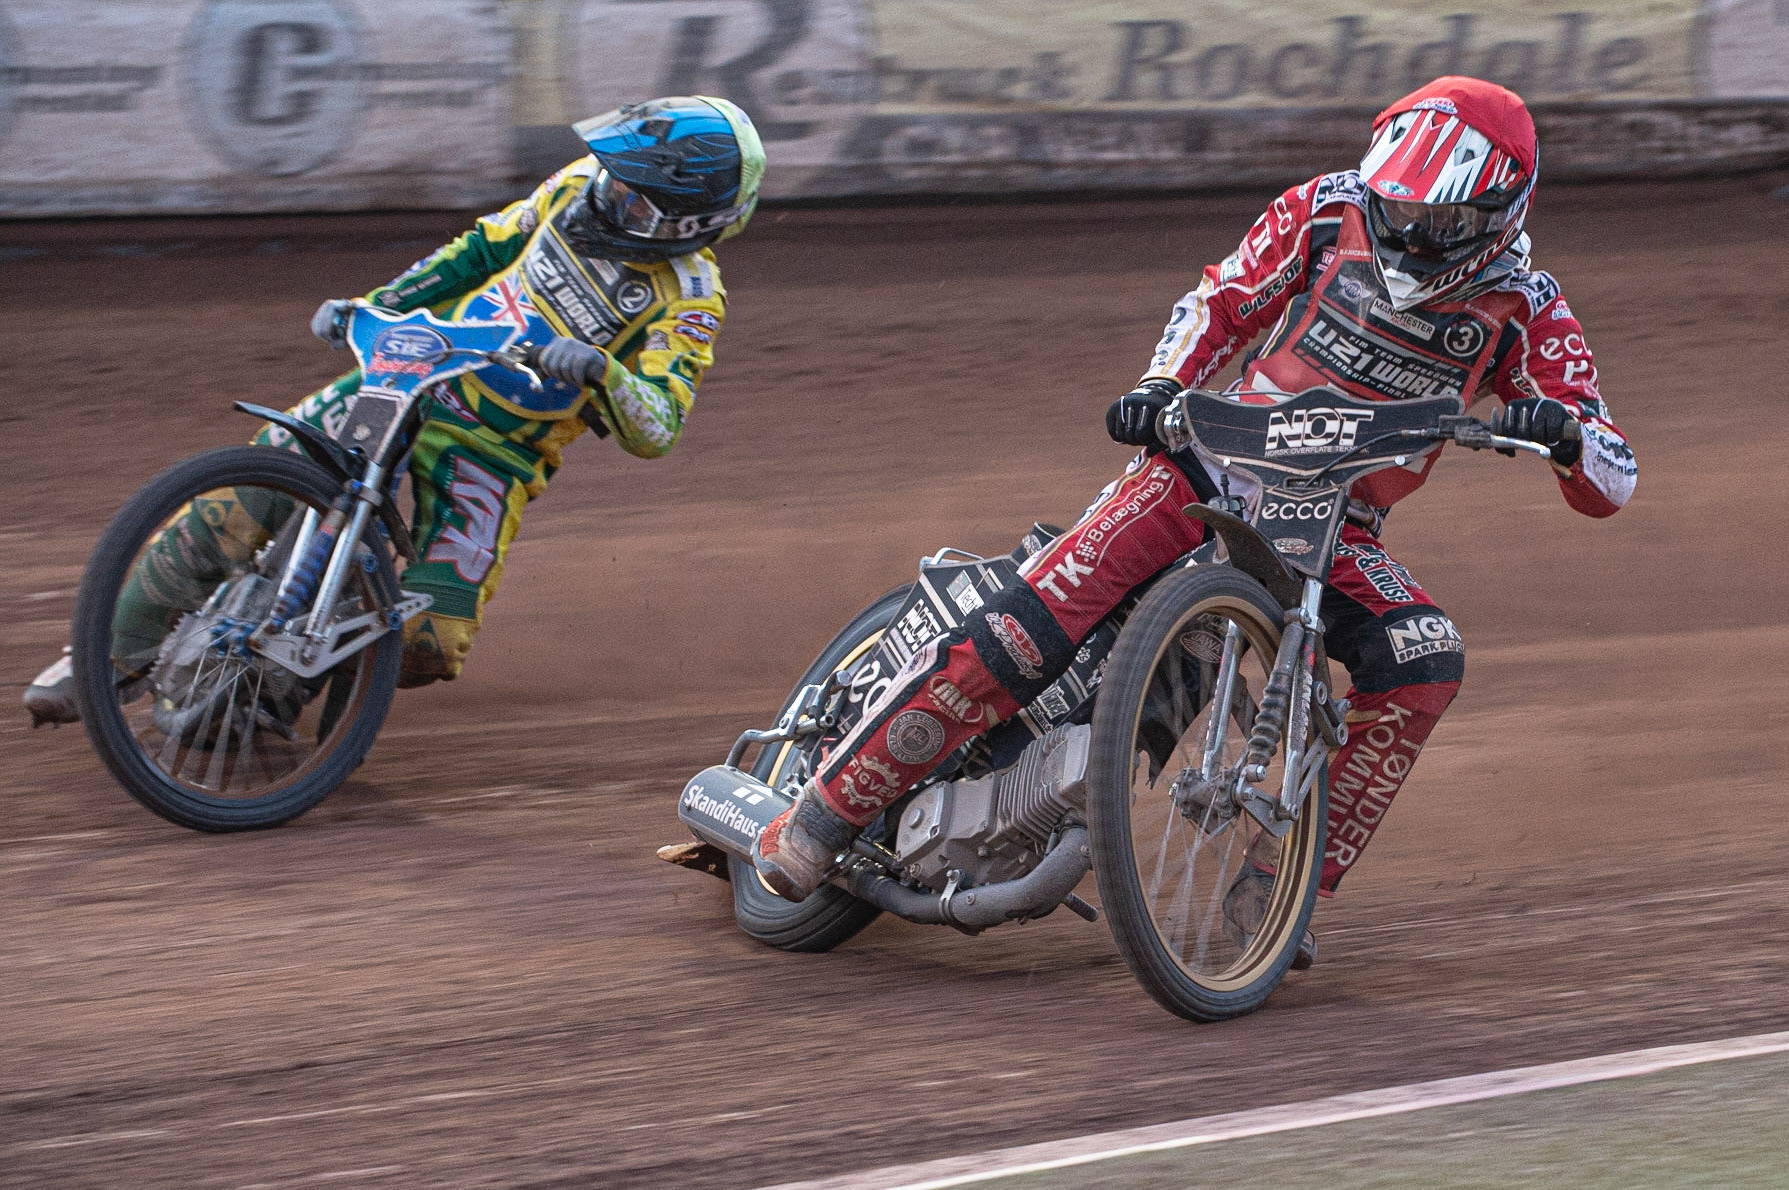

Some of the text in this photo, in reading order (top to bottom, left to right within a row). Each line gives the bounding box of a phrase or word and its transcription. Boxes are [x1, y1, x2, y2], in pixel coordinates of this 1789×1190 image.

[1107, 10, 1652, 103] Rochdale
[621, 287, 646, 309] 2
[1373, 299, 1434, 336] MANCHESTER
[1308, 319, 1375, 373] U21
[1451, 326, 1475, 352] 3
[1348, 335, 1464, 388] FIM TEAM SPEEDWAY
[1265, 407, 1375, 450] NOT
[1265, 448, 1289, 457] NORSK
[1291, 446, 1332, 454] OVERFLATE
[1261, 501, 1333, 520] ecco
[1036, 551, 1095, 602] TK
[1087, 481, 1164, 543] Belægning
[898, 599, 942, 652] NOT
[1388, 616, 1462, 650] NGK
[1399, 641, 1439, 662] SPARK
[1325, 738, 1424, 867] TØNDER
